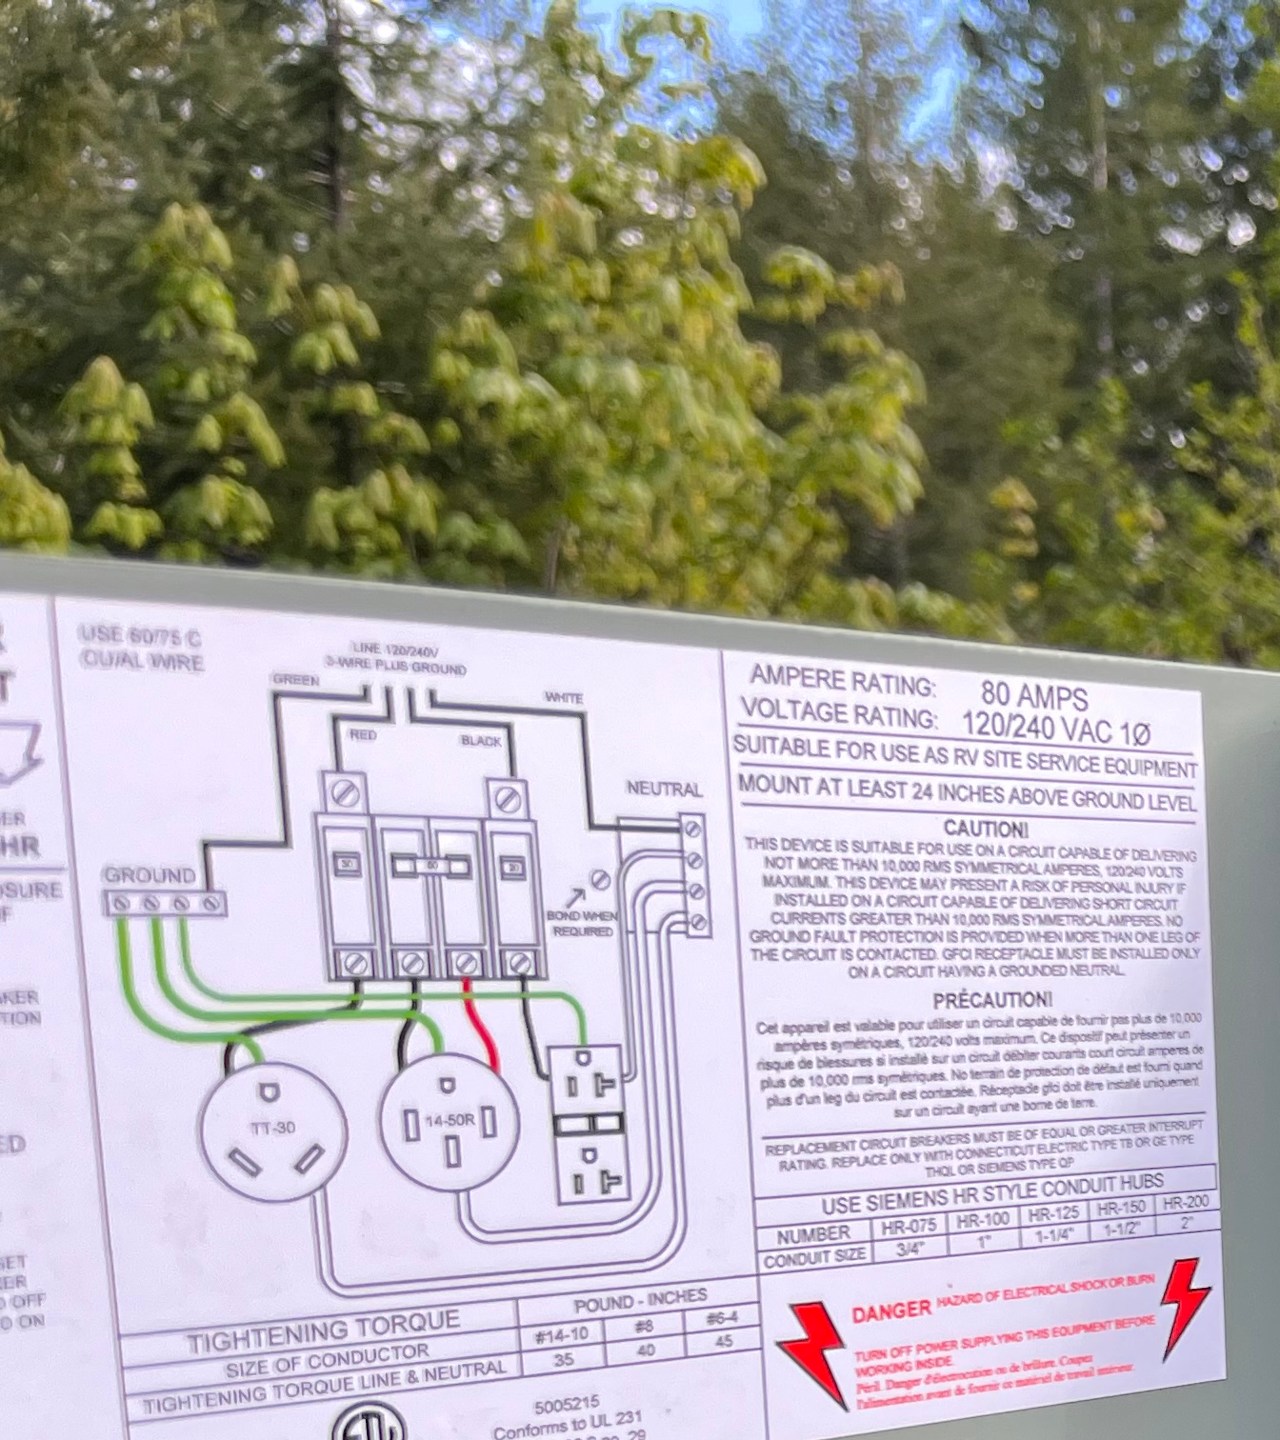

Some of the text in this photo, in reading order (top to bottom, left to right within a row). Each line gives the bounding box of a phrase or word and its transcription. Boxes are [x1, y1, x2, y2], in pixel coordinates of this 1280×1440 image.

[353, 642, 439, 659] LINE 120/240V
[272, 673, 320, 687] GREEN
[749, 663, 937, 698] AMPERE RATING:
[545, 691, 584, 705] WHITE
[981, 679, 1089, 712] 80 AMPS
[740, 695, 938, 730] VOLTAGE RATING:
[349, 728, 378, 741] RED
[962, 709, 1055, 741] 120/240
[1060, 716, 1113, 744] VAC
[460, 734, 503, 748] BLACK
[733, 733, 1199, 779] SUITABLE FOR USE AS RV SITE SERVICE EQUIPMENT
[627, 780, 704, 798] NEUTRAL
[738, 772, 1198, 813] MOUNT AT LEAST 24 INCHES ABOVE GROUND LEVEL
[943, 818, 1029, 839] CAUTION!
[101, 866, 197, 885] GROUND
[933, 989, 1053, 1010] PRÉCAUTION!
[249, 1120, 296, 1136] TT-30
[425, 1112, 476, 1128] 14-50R
[821, 1172, 1165, 1216] USE SIEMENS HR STYLE CONDUIT HUBS
[1163, 1193, 1210, 1210] HR-200
[1028, 1204, 1080, 1223] HR-125
[1097, 1199, 1147, 1217] HR-150
[881, 1217, 938, 1236] HR-075
[956, 1210, 1010, 1229] HR-100
[1104, 1220, 1142, 1237] 1-1/2"
[777, 1224, 851, 1246] NUMBER
[1035, 1226, 1075, 1243] 1-1/4"
[763, 1246, 867, 1270] CONDUIT SIZE
[896, 1241, 926, 1258] 3/4"
[573, 1287, 708, 1314] POUND INCHES
[852, 1299, 932, 1324] DANGER
[186, 1308, 461, 1355] TIGHTENING TORQUE
[534, 1325, 589, 1345] #14-10
[634, 1319, 654, 1334] #8
[636, 1343, 656, 1357] 40
[714, 1334, 734, 1348] 45
[226, 1342, 430, 1379] SIZE OF CONDUCTOR
[553, 1352, 575, 1368] 35
[142, 1359, 508, 1415] TIGHTENING TORQUE LINE & NEUTRAL
[534, 1393, 600, 1415] 5005215
[570, 1418, 588, 1432] to
[590, 1413, 611, 1429] UL
[615, 1409, 642, 1426] 231
